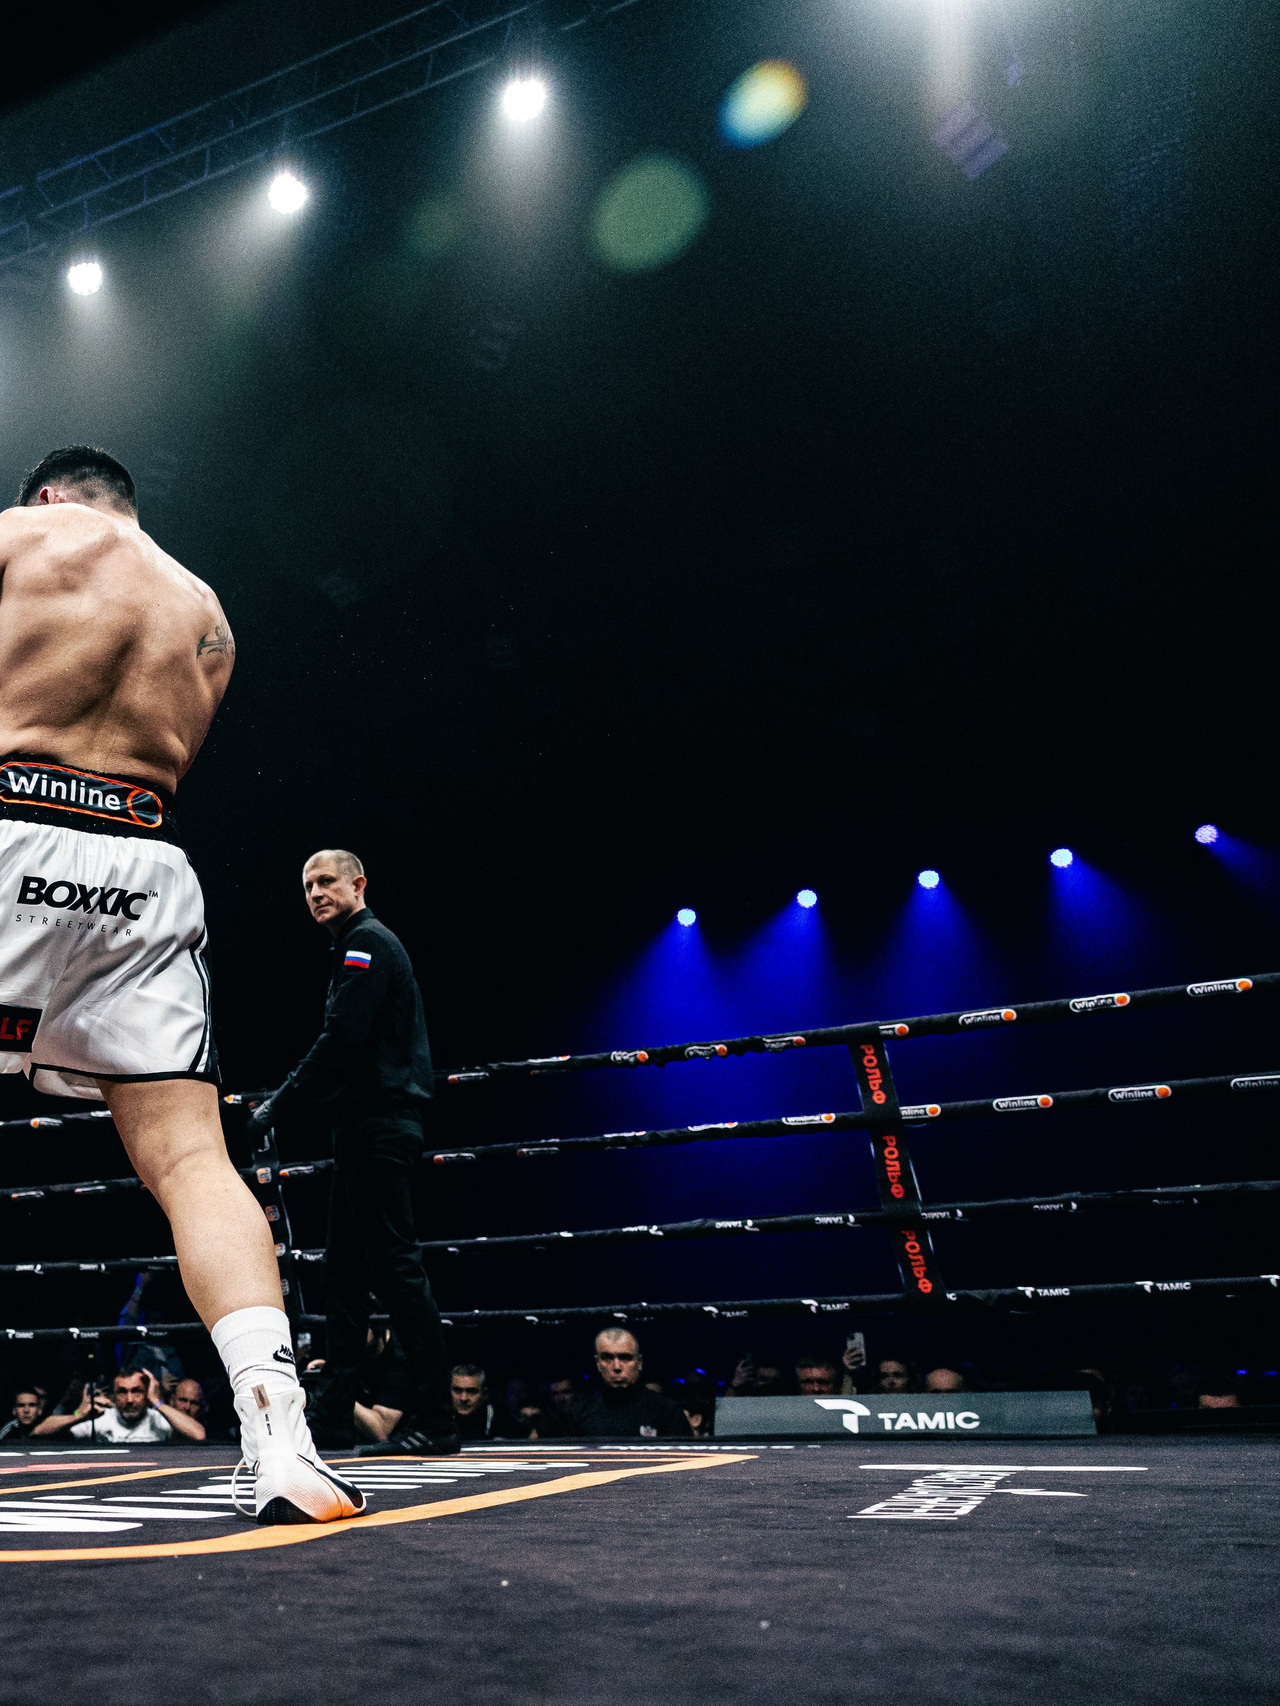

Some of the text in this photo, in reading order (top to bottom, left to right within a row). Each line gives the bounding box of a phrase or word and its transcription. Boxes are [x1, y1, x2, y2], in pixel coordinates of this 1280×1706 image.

[8, 771, 121, 811] Winline
[17, 875, 148, 921] BOXXIC
[16, 914, 132, 936] STREETWEAR
[1193, 982, 1235, 995] Winline
[963, 1012, 1001, 1026] Winline
[1112, 1088, 1153, 1101] Winline
[998, 1098, 1036, 1111] Winline
[902, 1107, 926, 1117] nline
[1037, 1286, 1070, 1297] TAMIC
[1156, 1282, 1192, 1291] TAMIC
[821, 1302, 850, 1311] TAMIC
[878, 1411, 981, 1431] TAMIC
